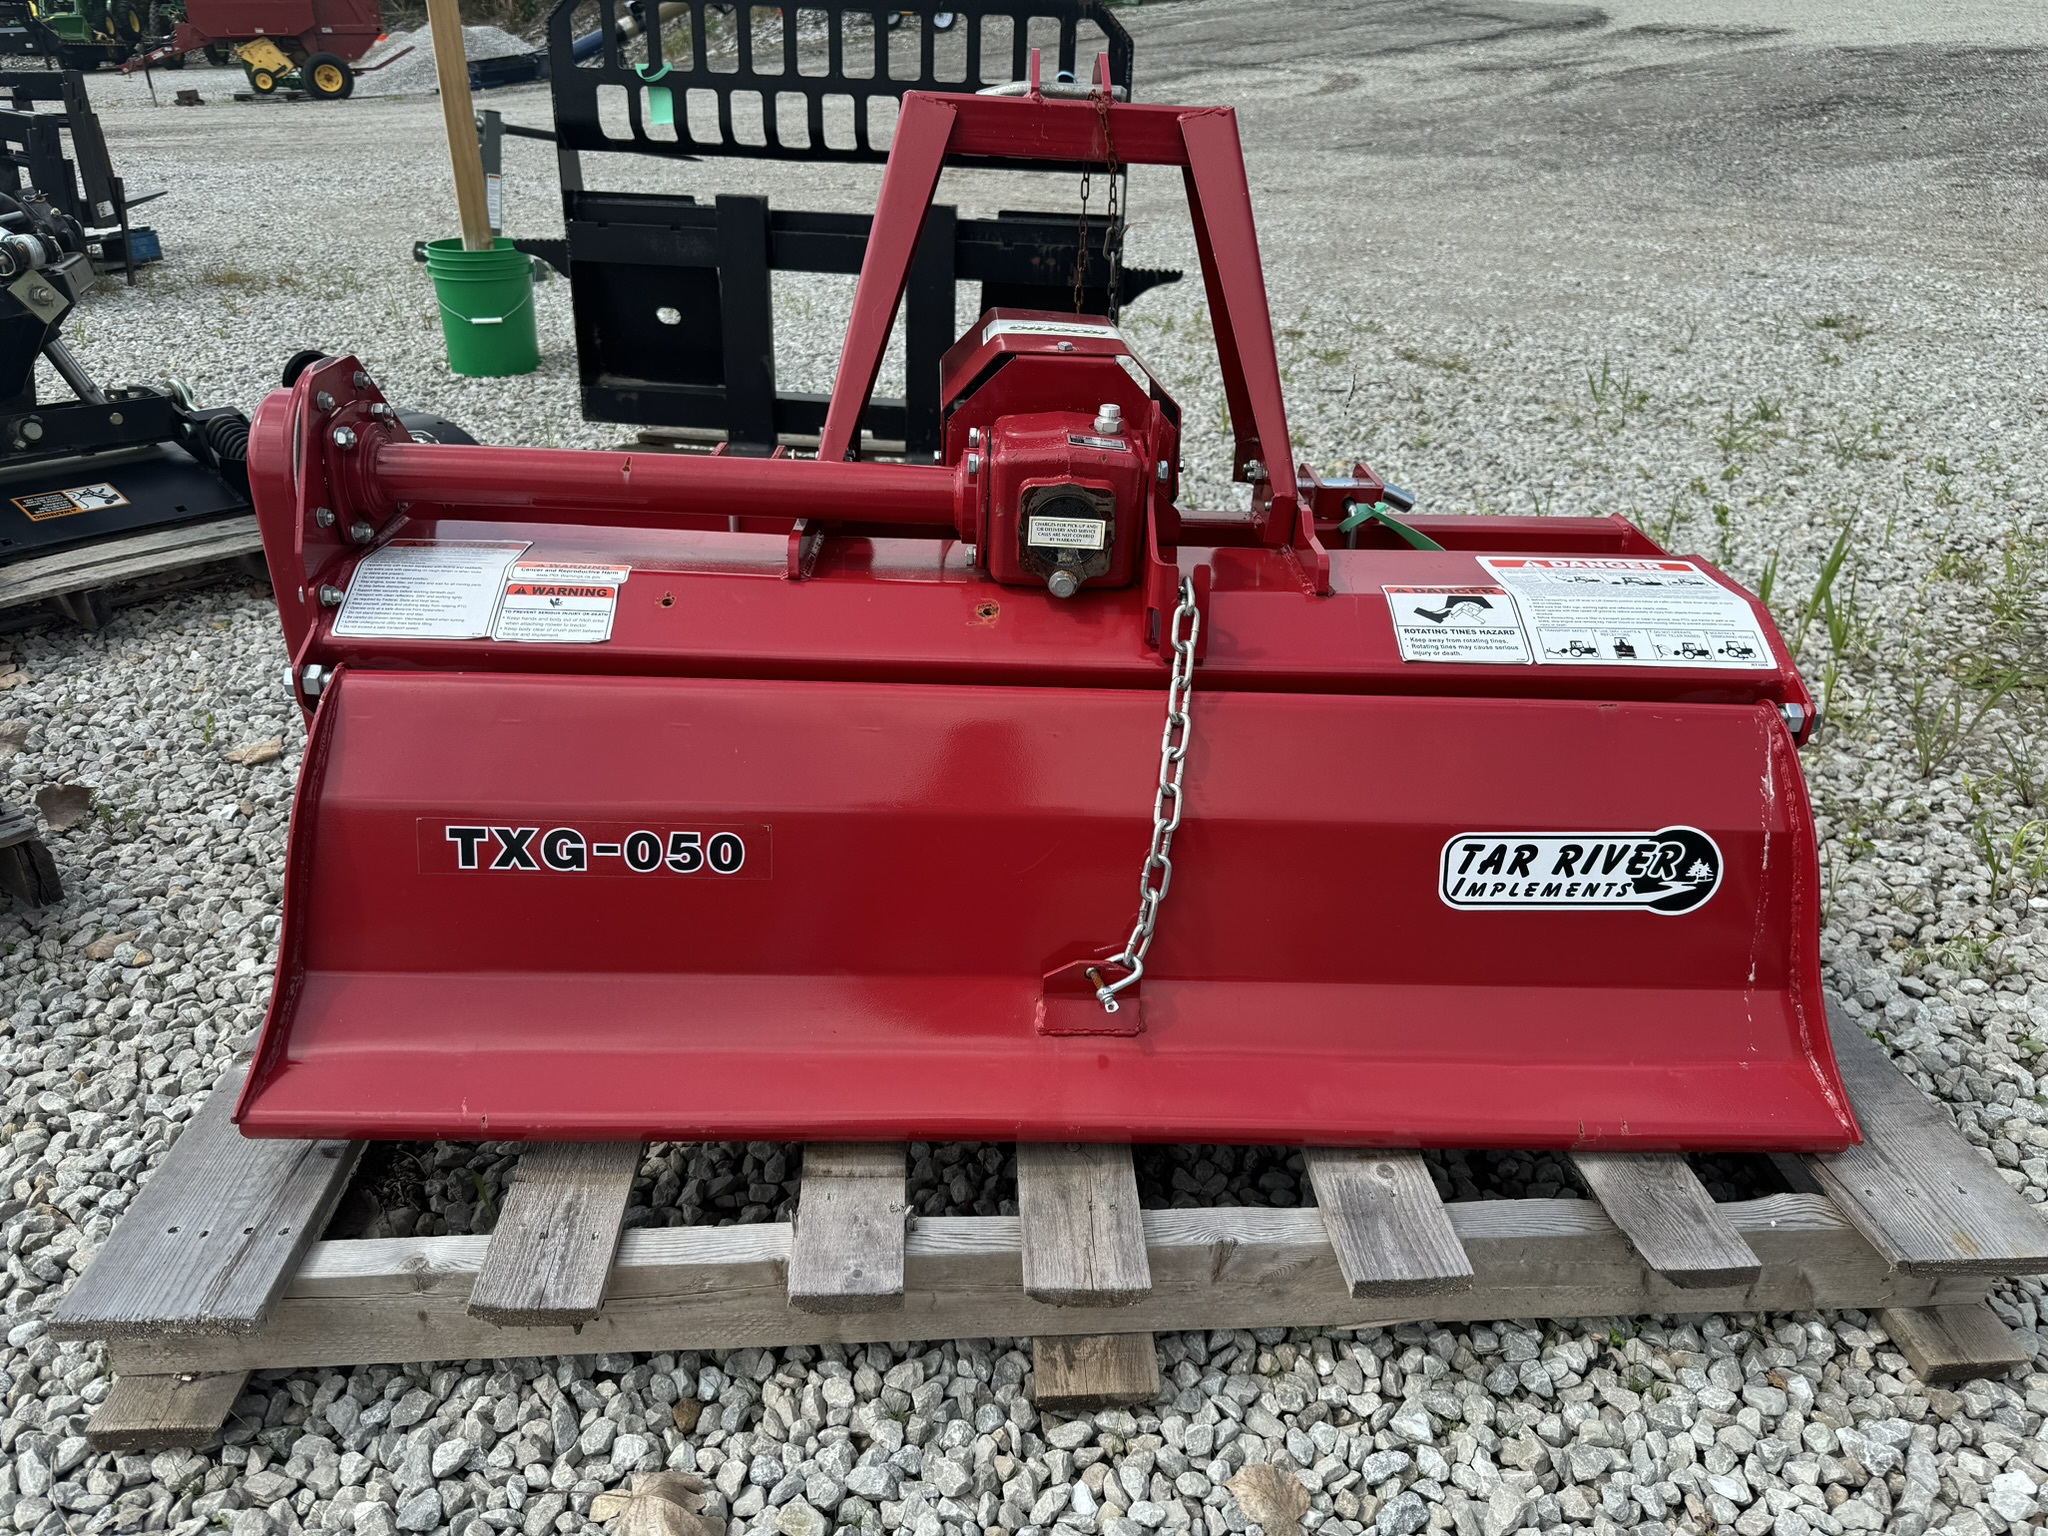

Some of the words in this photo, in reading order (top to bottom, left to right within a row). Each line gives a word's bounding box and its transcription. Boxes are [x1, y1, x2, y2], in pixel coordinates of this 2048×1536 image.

[1549, 561, 1664, 570] DANGER
[532, 586, 608, 596] WARNING
[446, 826, 745, 873] TXG-050
[1457, 843, 1539, 878] TAR
[1551, 843, 1684, 879] RIVER
[1450, 877, 1633, 898] IMPLEMENTS
